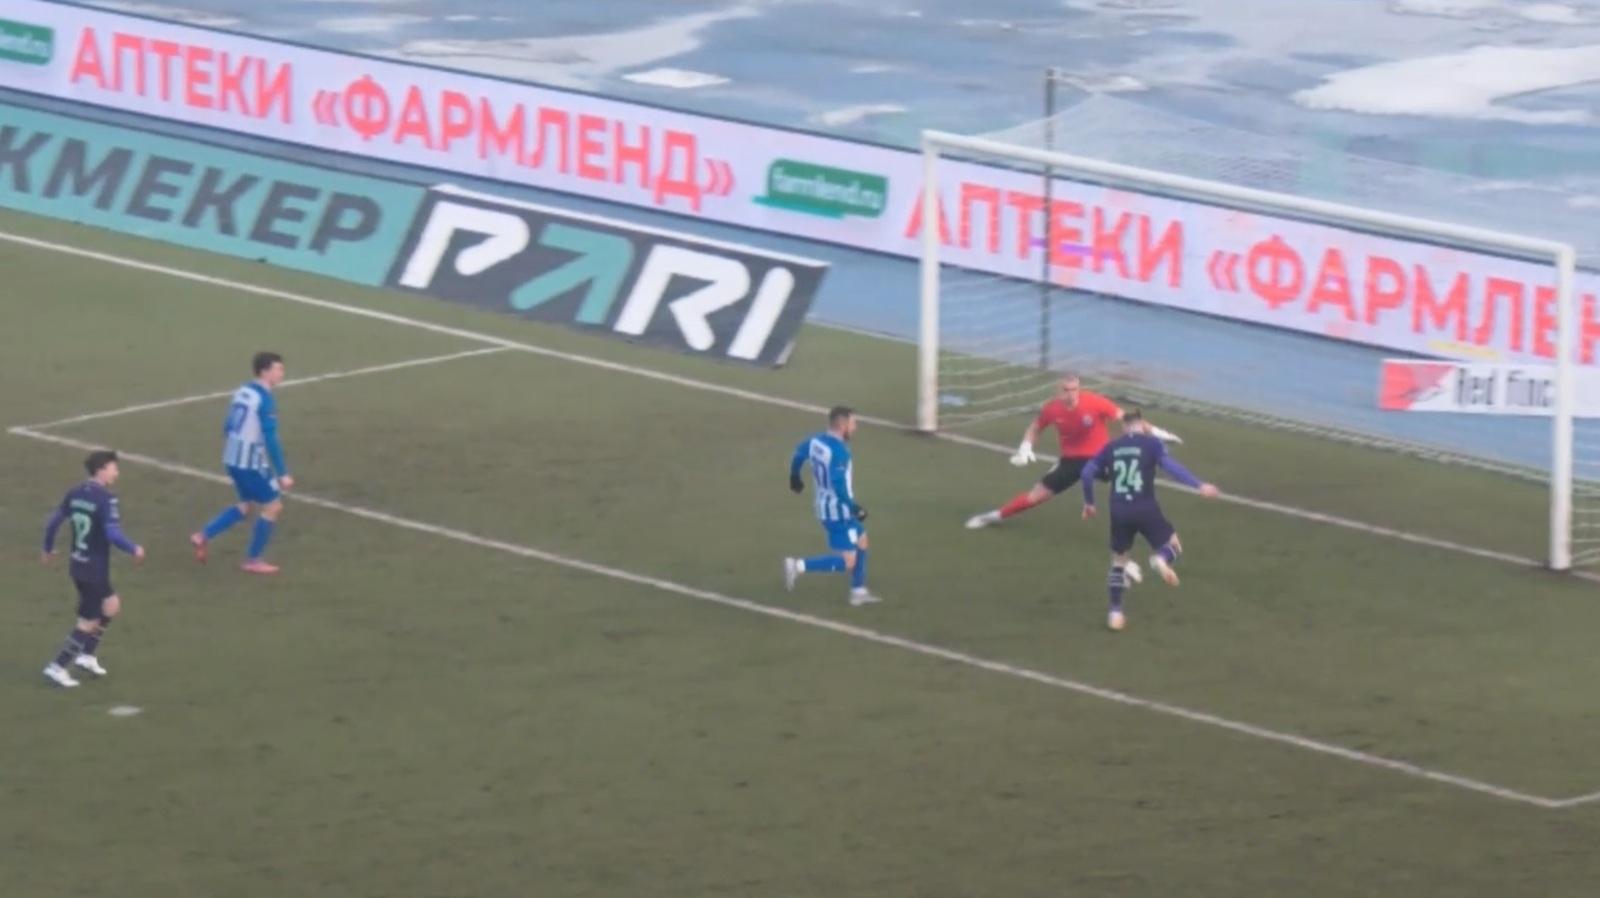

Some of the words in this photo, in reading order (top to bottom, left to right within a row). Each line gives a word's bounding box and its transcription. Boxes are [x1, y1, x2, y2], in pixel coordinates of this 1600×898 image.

[70, 26, 292, 125] АПТЕКИ
[312, 74, 735, 211] «ФАРМЛЕНД»
[0, 125, 381, 254] КМЕКЕР
[904, 181, 1184, 288] АПТЕКИ
[399, 200, 795, 361] PARI
[1113, 458, 1143, 493] 24
